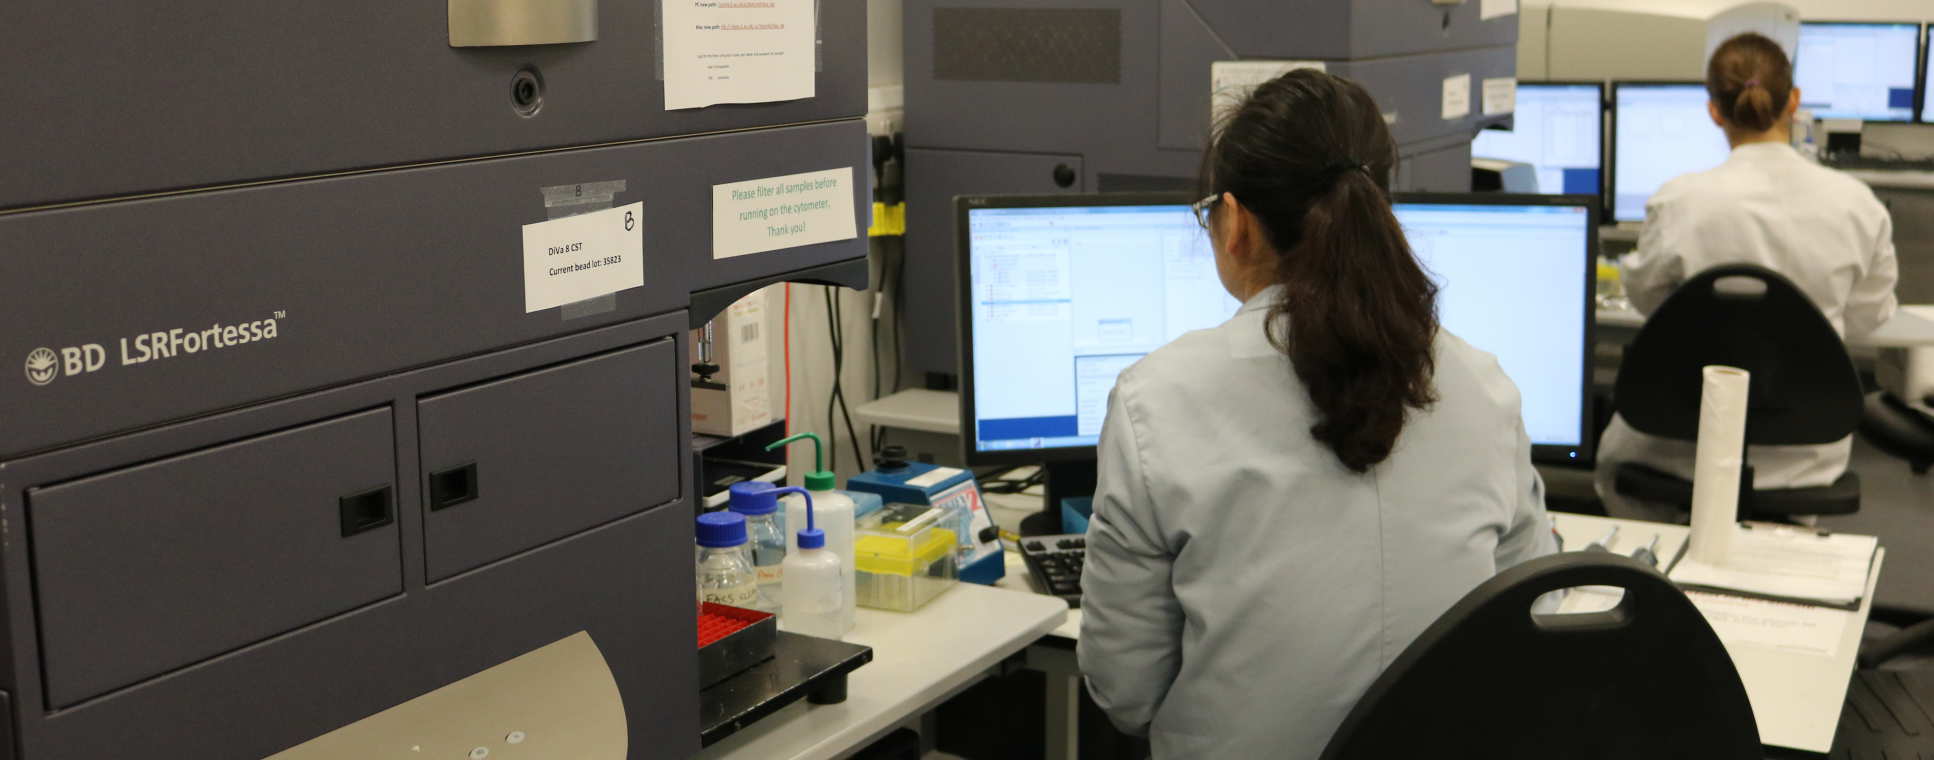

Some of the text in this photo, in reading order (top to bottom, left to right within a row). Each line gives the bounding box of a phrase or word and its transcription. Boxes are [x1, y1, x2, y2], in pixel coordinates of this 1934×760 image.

[732, 177, 837, 200] Please filter all samples before
[624, 210, 635, 232] B
[739, 207, 768, 222] running
[769, 206, 779, 217] on
[780, 203, 792, 215] the
[767, 221, 806, 237] Thank you!
[565, 244, 570, 253] 8
[571, 242, 583, 252] CST
[549, 264, 574, 277] Current
[575, 261, 591, 271] bead
[591, 259, 602, 269] lot:
[61, 343, 106, 376] BD
